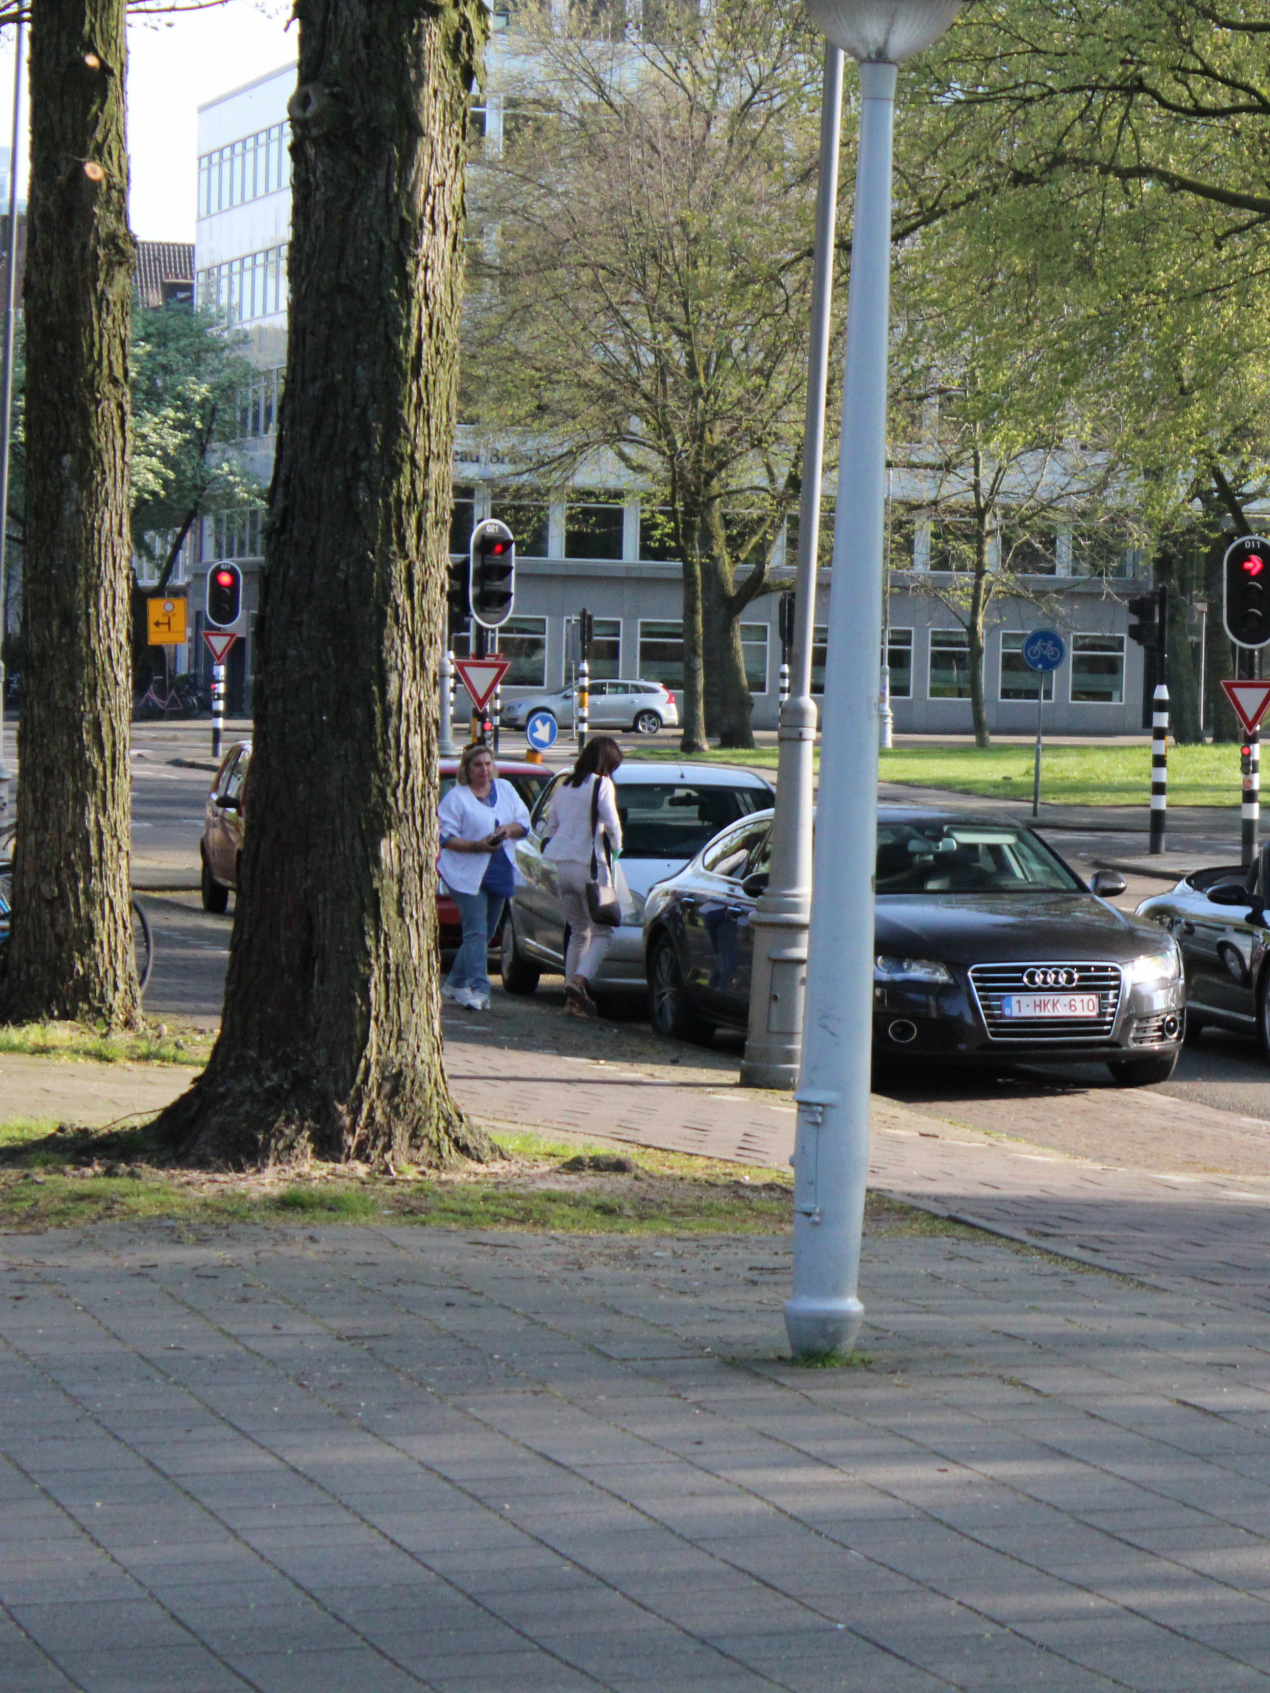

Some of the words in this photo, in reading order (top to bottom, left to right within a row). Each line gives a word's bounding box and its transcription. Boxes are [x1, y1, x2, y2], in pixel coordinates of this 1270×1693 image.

[486, 524, 499, 533] 021
[1244, 540, 1261, 549] 011
[1015, 998, 1096, 1013] 1-HKK-610
